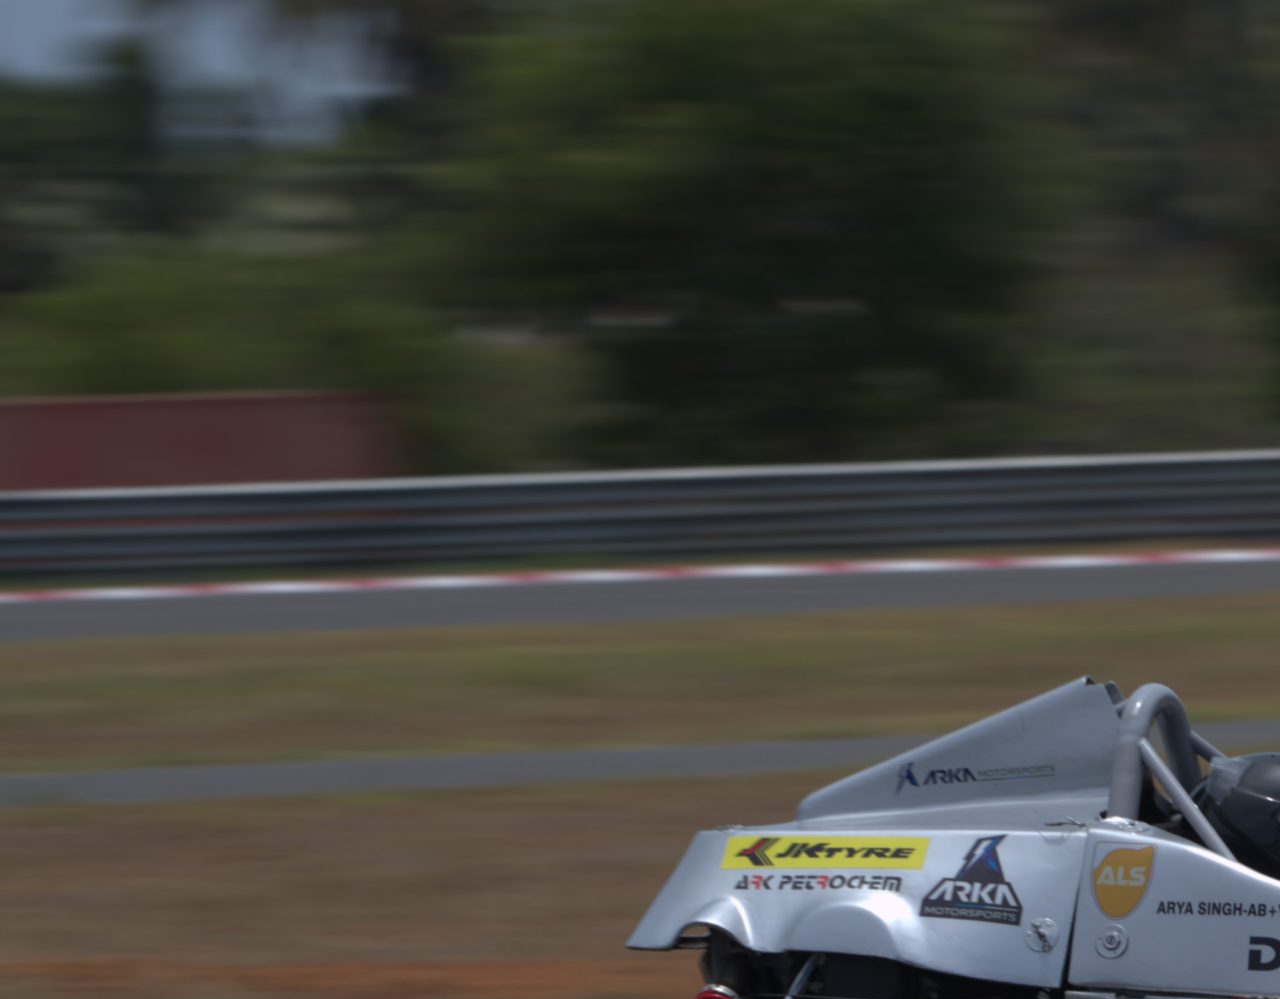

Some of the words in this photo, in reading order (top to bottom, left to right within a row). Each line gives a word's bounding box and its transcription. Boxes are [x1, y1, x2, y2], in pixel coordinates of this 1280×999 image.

[923, 767, 977, 786] ARKA
[734, 875, 774, 891] ARK
[778, 875, 903, 892] PETROCHEM
[1096, 866, 1147, 886] ALS
[928, 881, 1019, 907] ARKA
[924, 905, 1018, 923] MOTORSPORTS
[1156, 901, 1194, 915] ARYA
